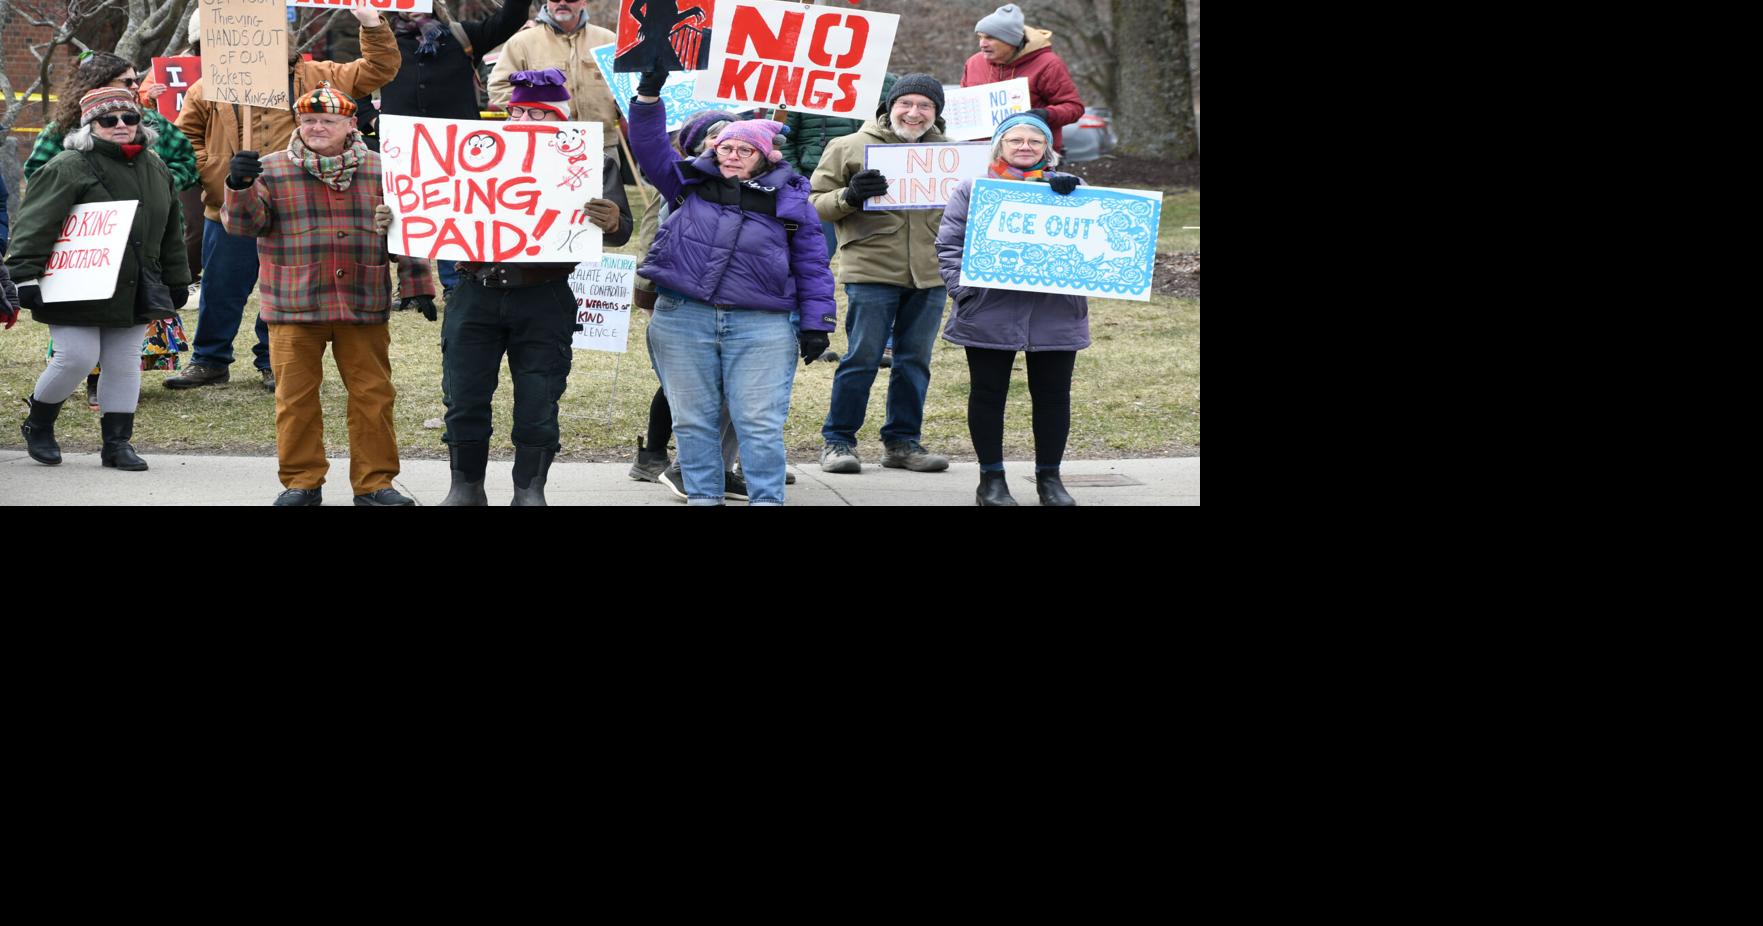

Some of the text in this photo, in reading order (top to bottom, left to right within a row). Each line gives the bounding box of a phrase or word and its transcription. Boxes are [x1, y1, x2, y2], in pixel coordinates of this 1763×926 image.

[206, 28, 284, 48] HANDS OUT
[725, 4, 870, 69] NO
[240, 50, 267, 65] OUR
[166, 66, 188, 88] I
[716, 58, 862, 113] KINGS
[990, 90, 1007, 108] NO
[992, 107, 1018, 126] KIN
[410, 123, 560, 177] NOT
[906, 147, 960, 174] NO
[77, 209, 117, 236] KING
[998, 211, 1095, 239] ICE OUT
[605, 271, 627, 287] ANY
[577, 311, 604, 323] KIND
